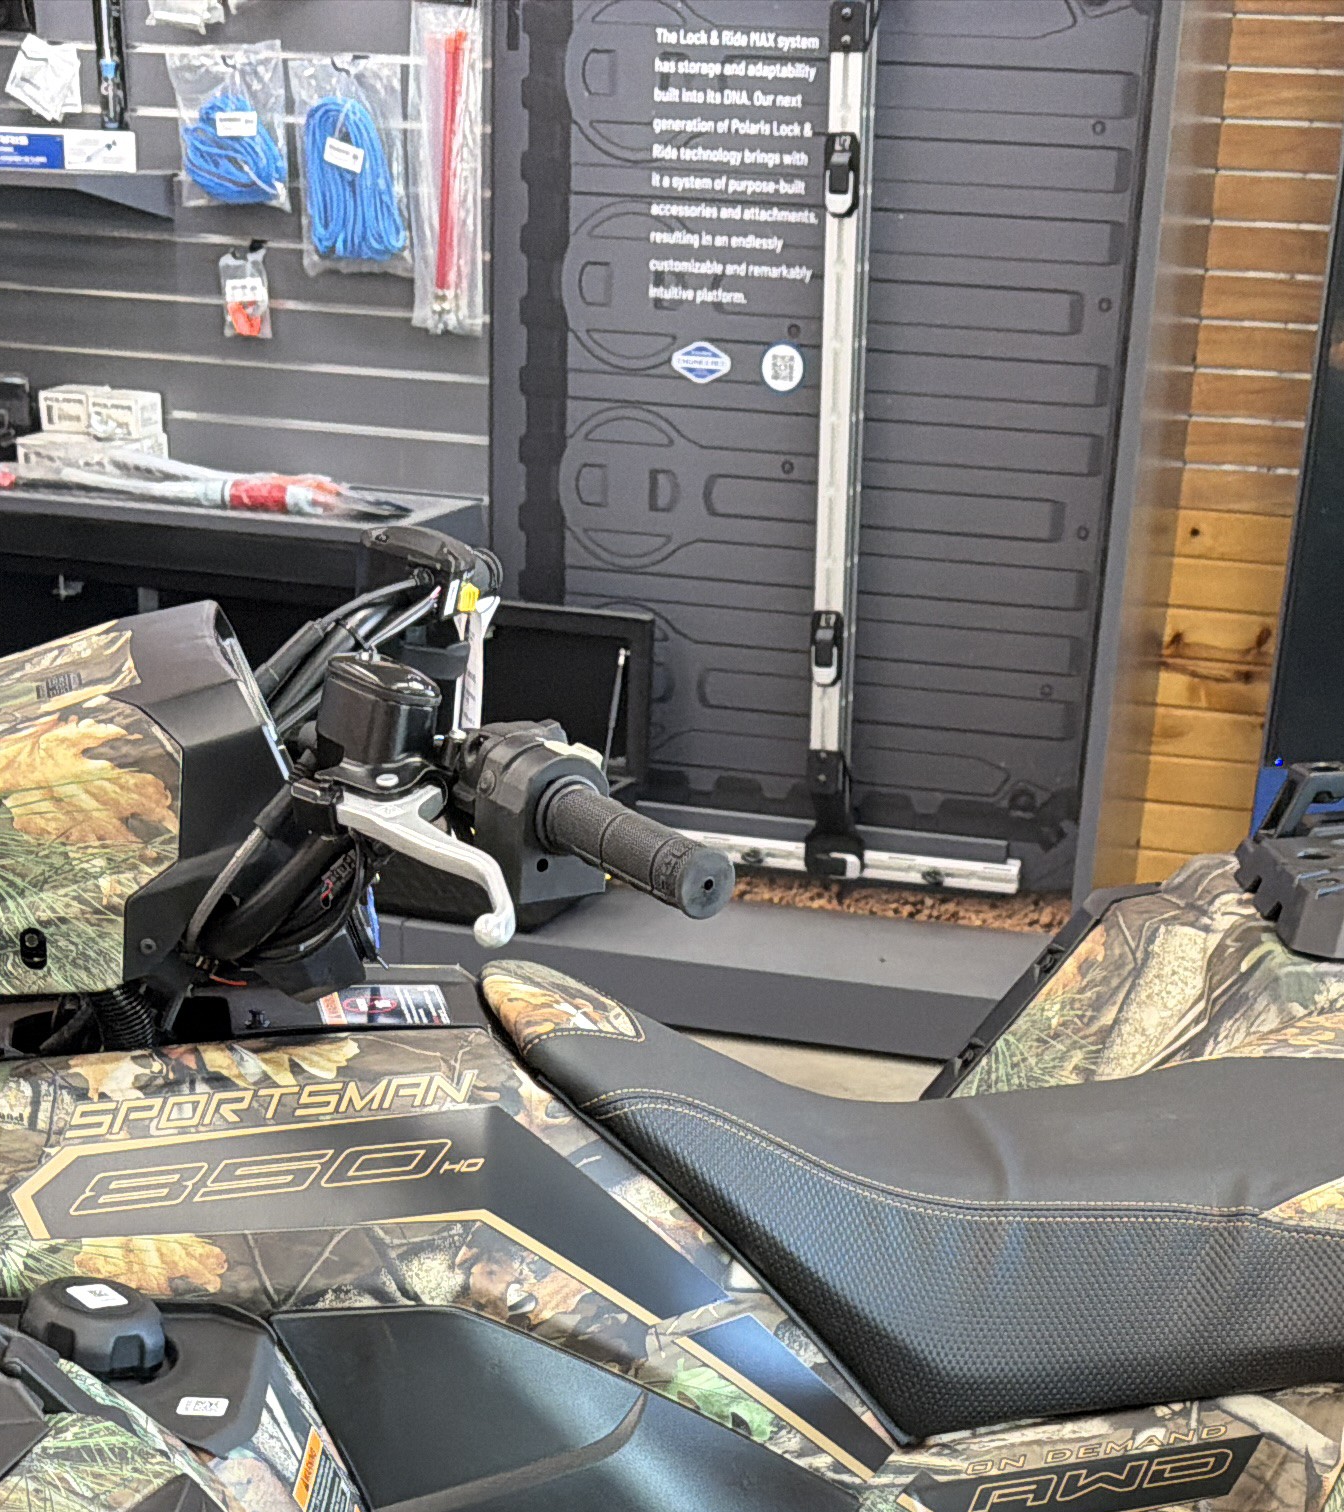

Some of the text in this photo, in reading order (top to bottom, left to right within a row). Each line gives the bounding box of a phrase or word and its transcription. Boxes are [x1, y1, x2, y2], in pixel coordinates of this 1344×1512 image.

[656, 27, 820, 51] The Lock & Ride MAX system
[655, 56, 817, 82] has storage and adaptability
[653, 86, 803, 108] built into its DNA. Our next
[653, 116, 814, 138] generation of Polaris Lock &
[652, 143, 809, 168] Ride technology brings with
[671, 175, 713, 192] system
[713, 175, 727, 191] of
[728, 177, 806, 195] purpose-built
[650, 202, 718, 219] accessories
[719, 204, 742, 221] and
[649, 228, 699, 248] resulting
[714, 234, 729, 247] an
[730, 234, 784, 254] endlessly
[649, 258, 813, 284] customizable and remarkably
[648, 283, 748, 305] intuitive platform.
[65, 1069, 479, 1138] SPORTSMAN
[70, 1138, 485, 1216] 850 HO
[965, 1424, 1229, 1476] ON DEMAND
